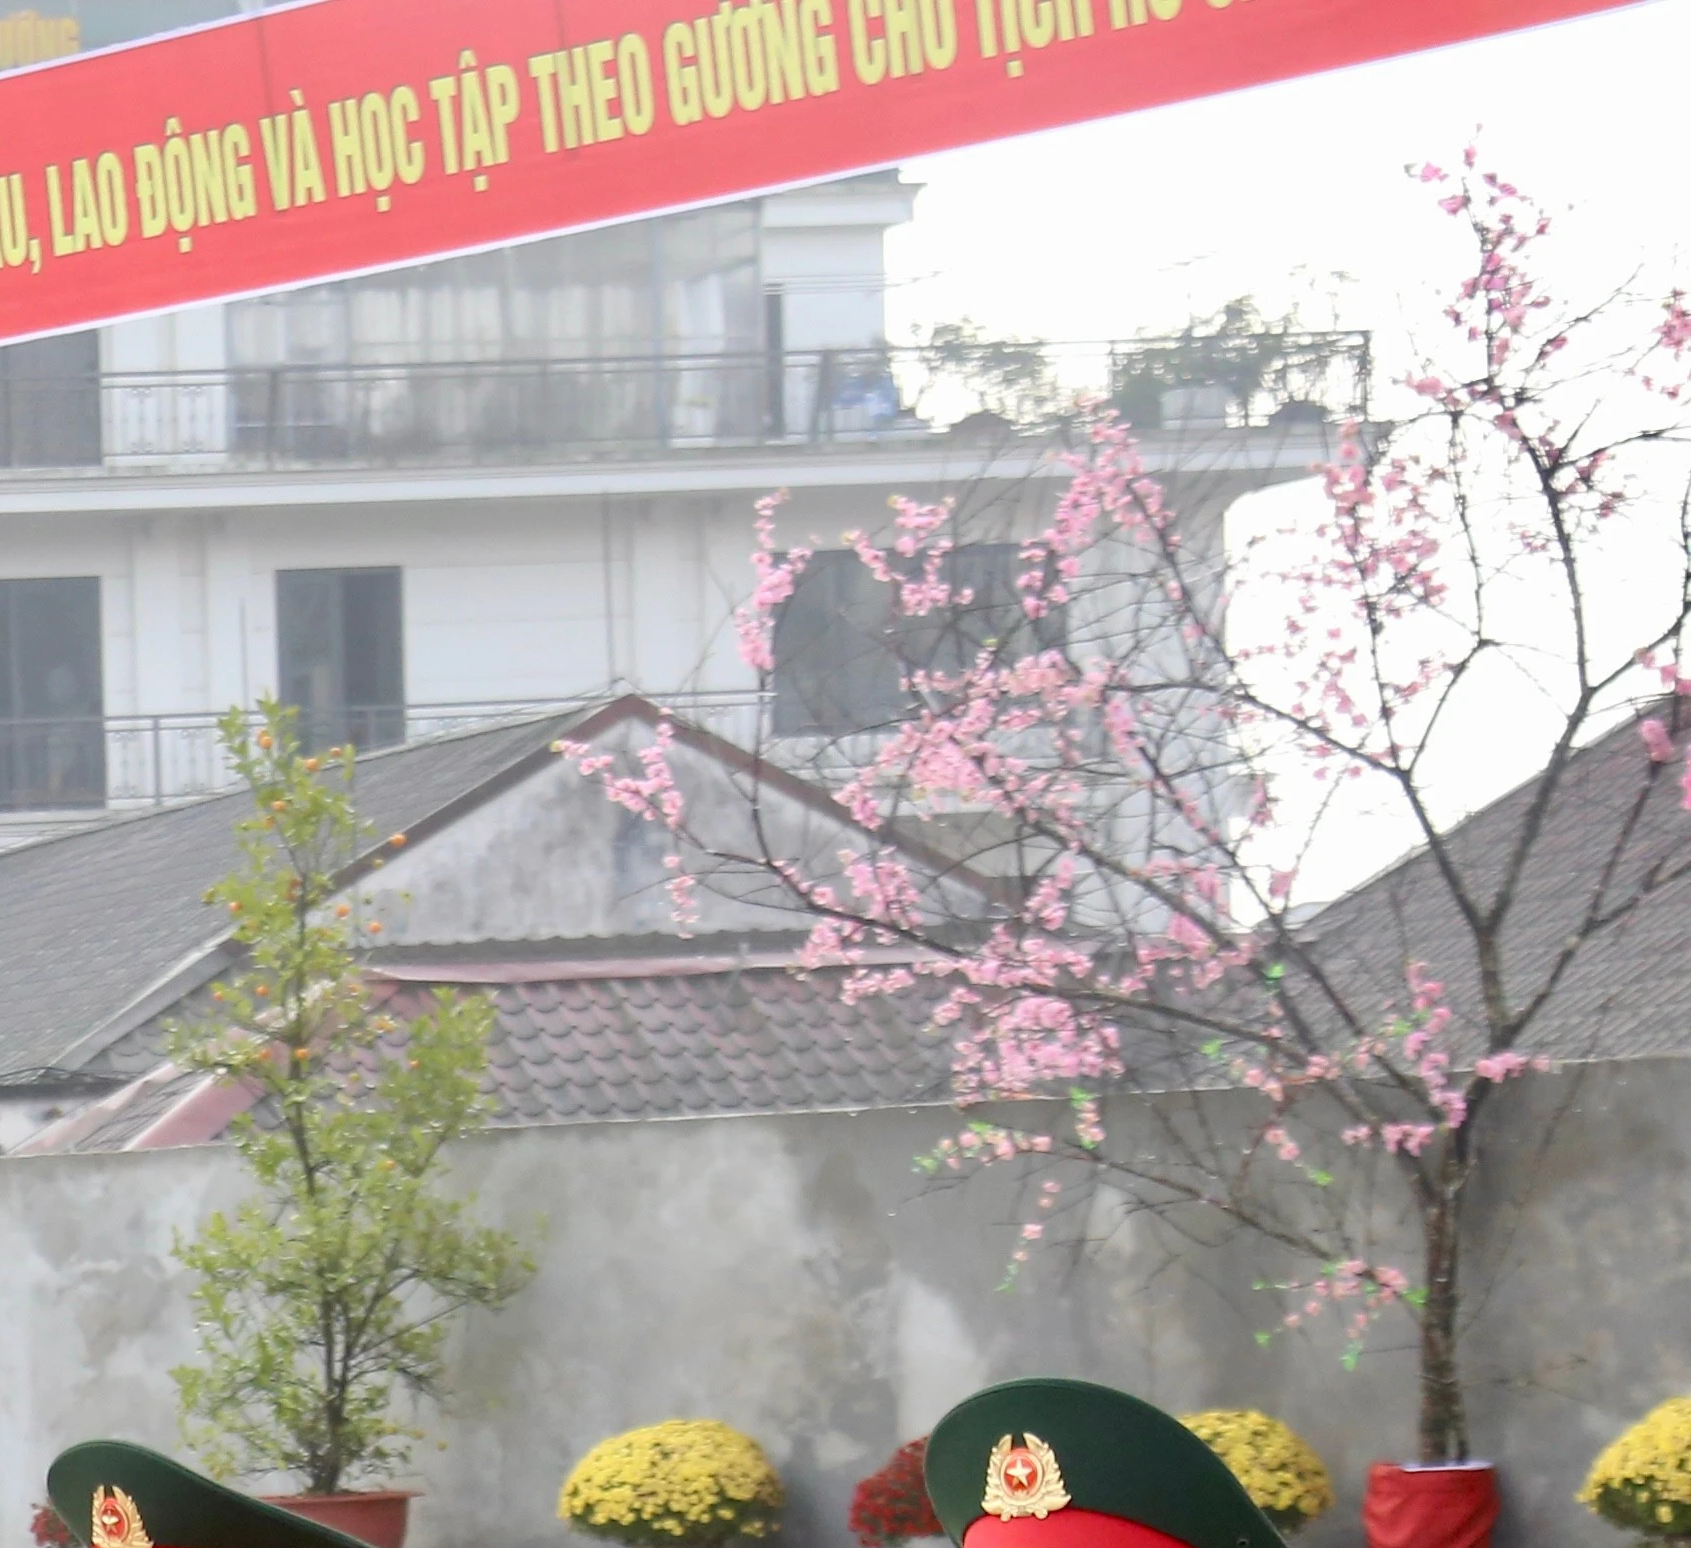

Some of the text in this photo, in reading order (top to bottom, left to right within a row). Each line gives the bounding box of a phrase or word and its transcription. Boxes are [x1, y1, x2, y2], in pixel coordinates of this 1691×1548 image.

[45, 151, 129, 257] LAO
[133, 115, 257, 253] ĐỘNG
[259, 88, 327, 211] VÀ
[328, 84, 425, 213] HỌC
[428, 49, 520, 192] TẬP
[528, 33, 654, 153] THEO
[663, 0, 840, 126] GƯƠNG
